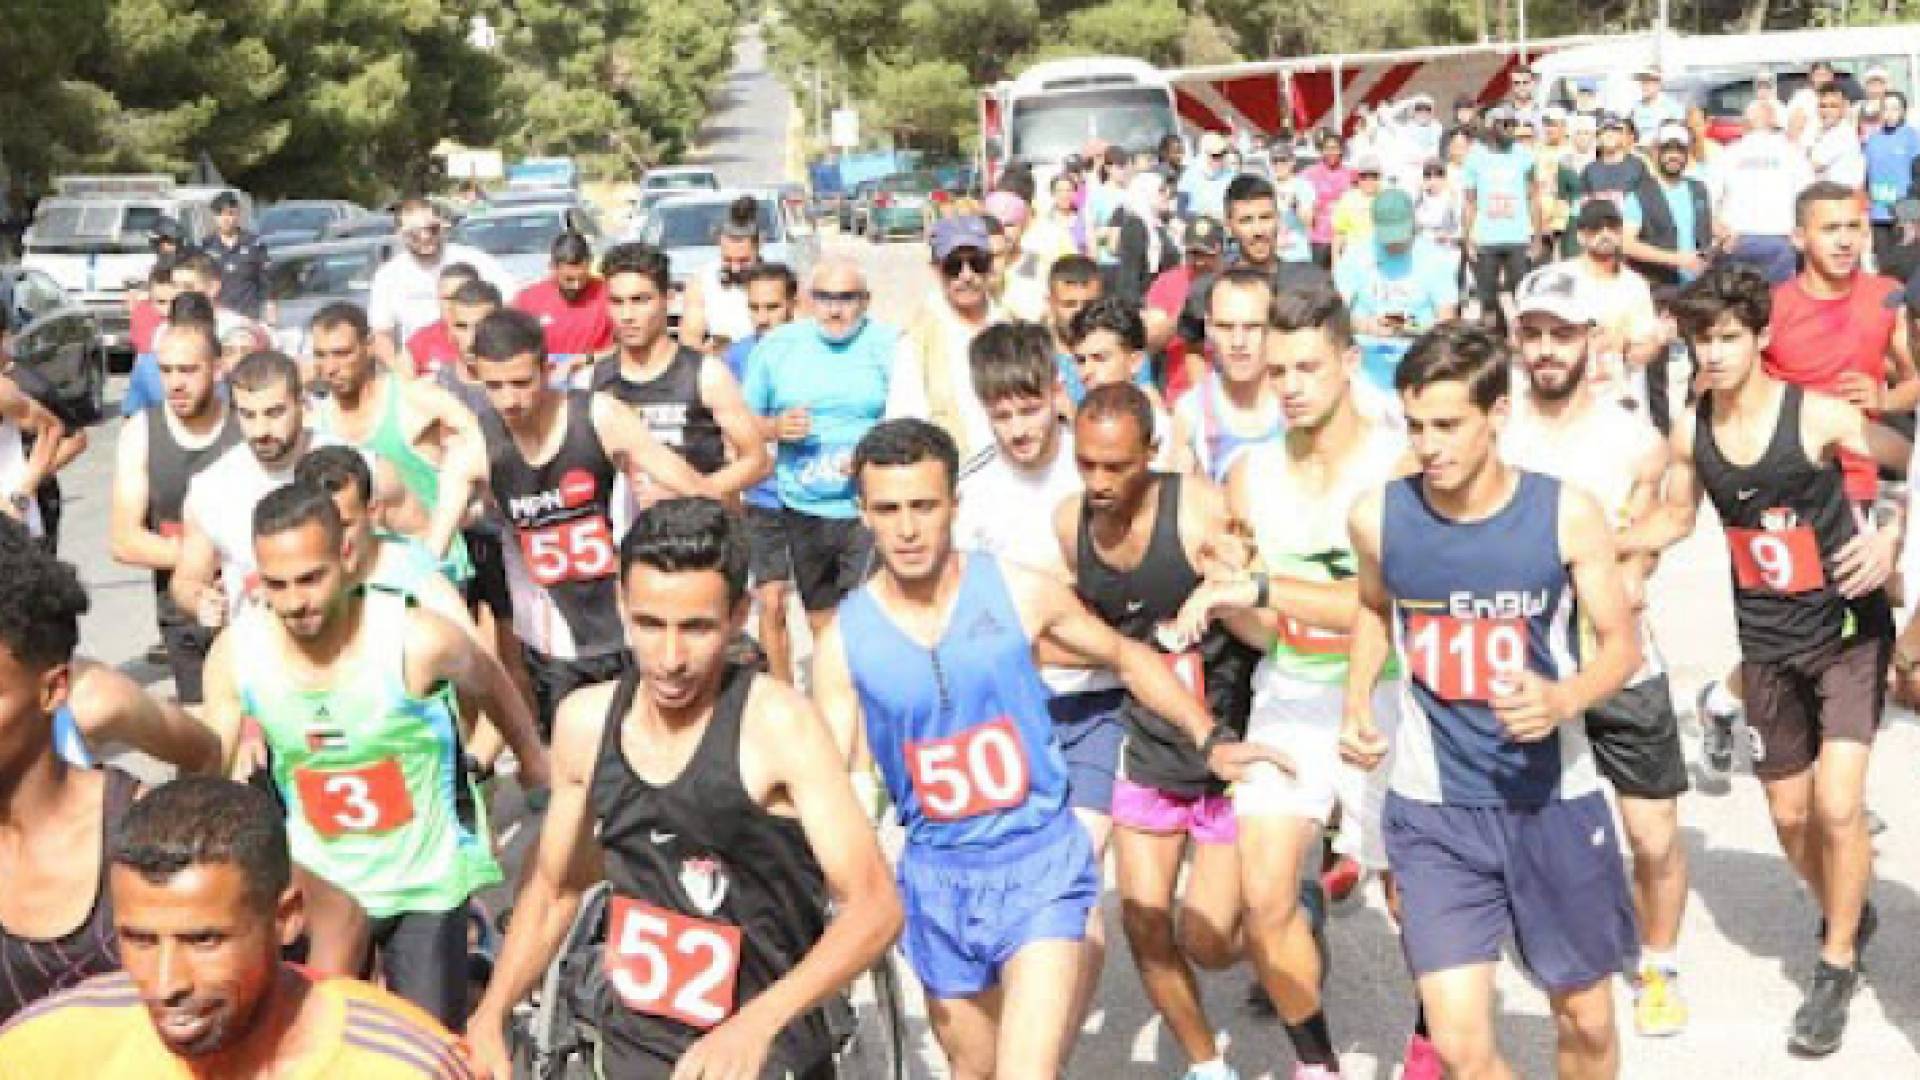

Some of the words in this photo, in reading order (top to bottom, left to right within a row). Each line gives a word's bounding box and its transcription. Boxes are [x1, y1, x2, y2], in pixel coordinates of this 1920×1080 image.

[530, 520, 611, 578] 55
[1749, 533, 1793, 590] 9
[1449, 589, 1549, 619] EnBW
[1413, 620, 1524, 696] 119
[917, 729, 1022, 816] 50
[323, 775, 379, 829] 3
[611, 908, 730, 1020] 52
